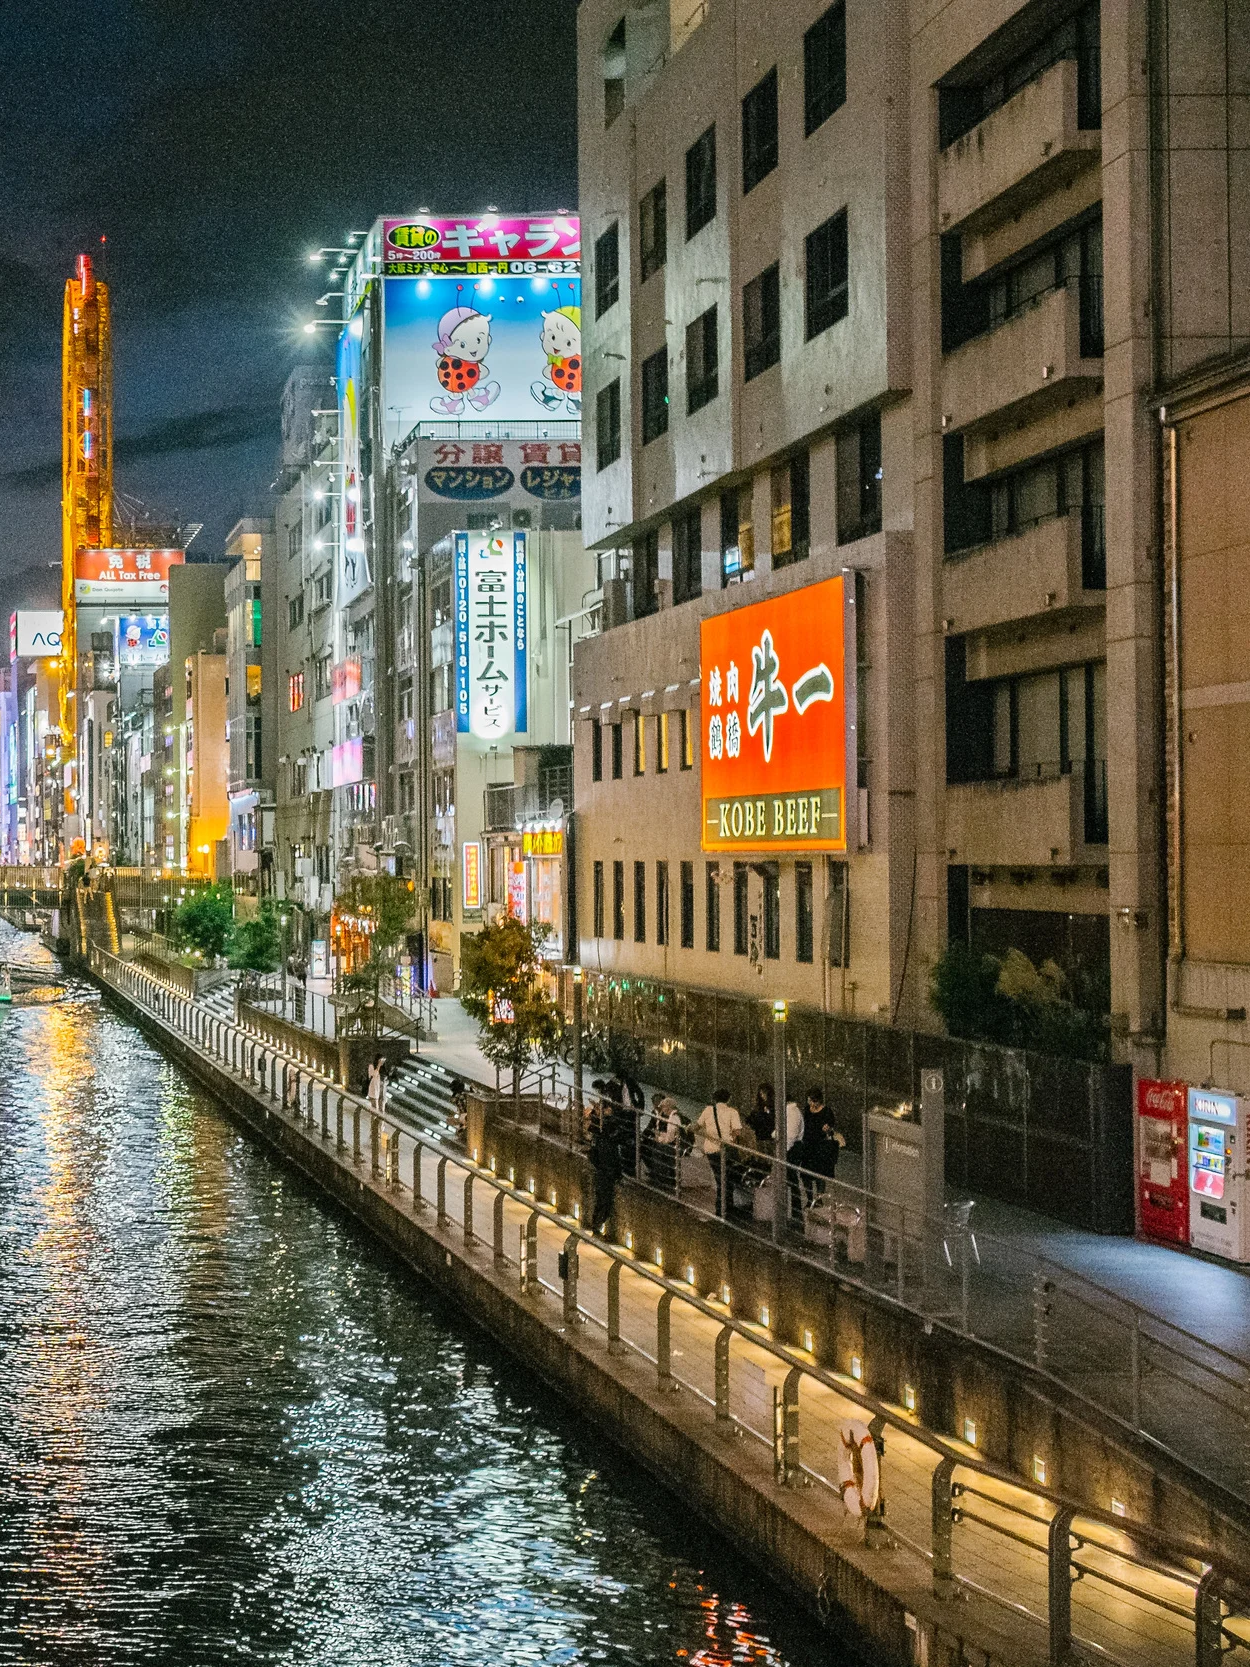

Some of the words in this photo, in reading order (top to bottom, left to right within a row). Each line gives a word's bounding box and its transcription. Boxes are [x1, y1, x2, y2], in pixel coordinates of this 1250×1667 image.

[395, 226, 437, 246] 賃貸の
[510, 261, 581, 274] 06-62
[434, 443, 503, 464] 分譲
[431, 470, 510, 488] マンション
[526, 470, 581, 488] レジャ
[108, 554, 151, 569] 免税
[99, 571, 116, 580] ALL
[118, 571, 136, 580] Tax
[139, 571, 161, 580] Free
[474, 570, 508, 728] 富士ホームサービス
[709, 661, 739, 706] 焼肉
[747, 629, 834, 763] 牛一
[709, 711, 741, 760] 鶴橋
[719, 800, 767, 837] KOBE
[773, 796, 821, 836] BEEF
[1194, 1098, 1219, 1116] KIRIN
